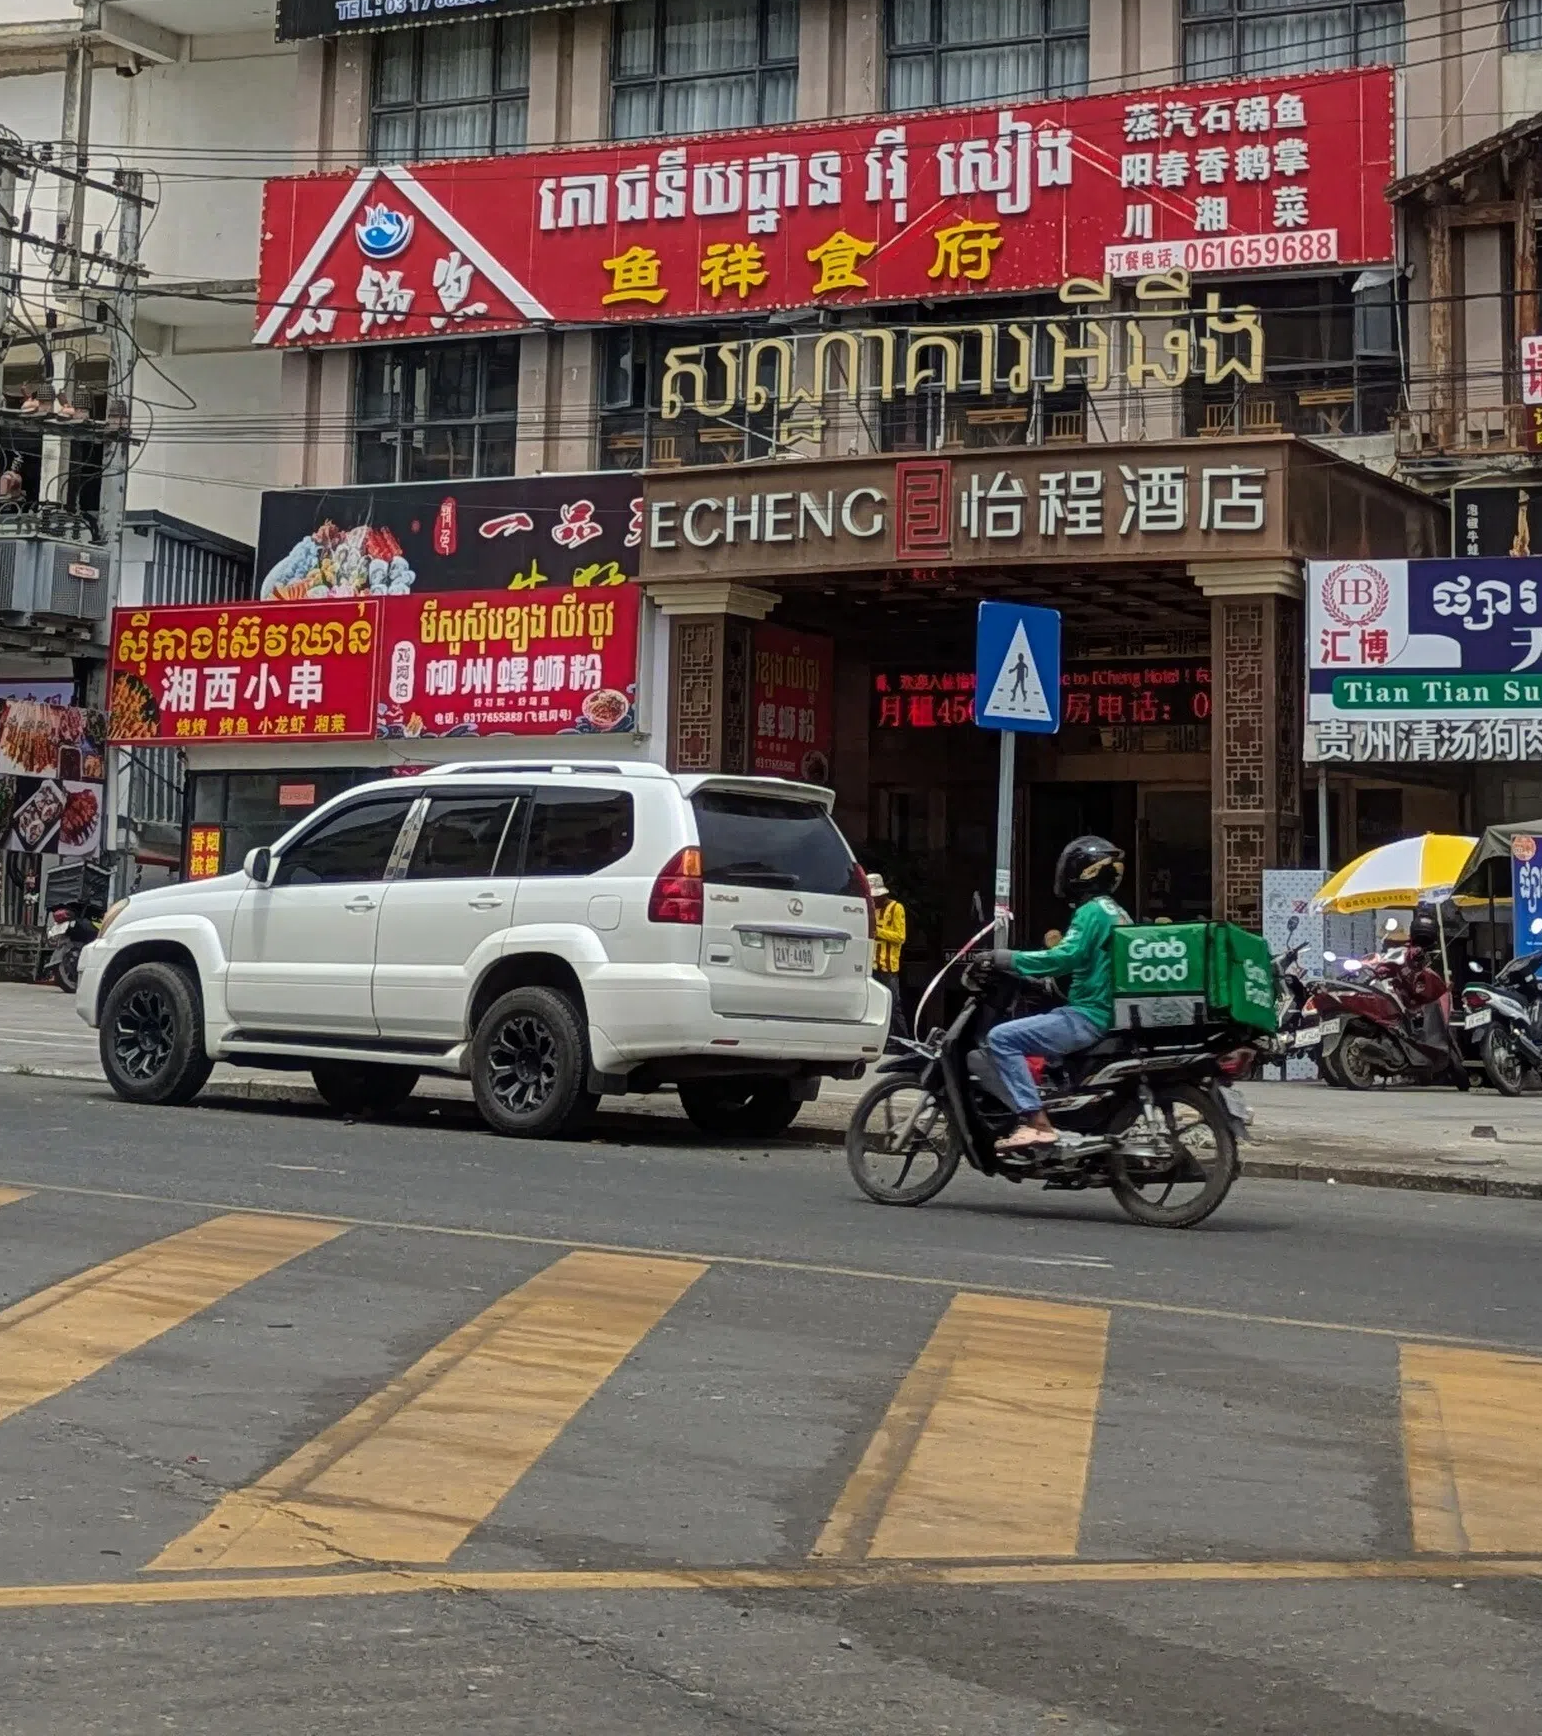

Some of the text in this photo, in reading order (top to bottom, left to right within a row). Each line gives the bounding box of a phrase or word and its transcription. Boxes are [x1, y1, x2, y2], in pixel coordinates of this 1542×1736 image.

[1122, 92, 1309, 142] 蒸汽石锅鱼
[601, 219, 1005, 306] 鱼祥食府
[1183, 232, 1334, 271] 061659688
[649, 487, 887, 550] ECHENG
[961, 465, 1270, 539] 怡程酒店
[1319, 627, 1390, 666] 汇博
[159, 659, 324, 713] 湘西小串
[425, 653, 603, 696] 柳州螺蛳粉
[1343, 679, 1410, 704] Tian
[1422, 678, 1490, 704] Tian
[257, 715, 306, 735] 小龙虾
[1127, 937, 1187, 960] Grab
[1127, 958, 1189, 984] Food
